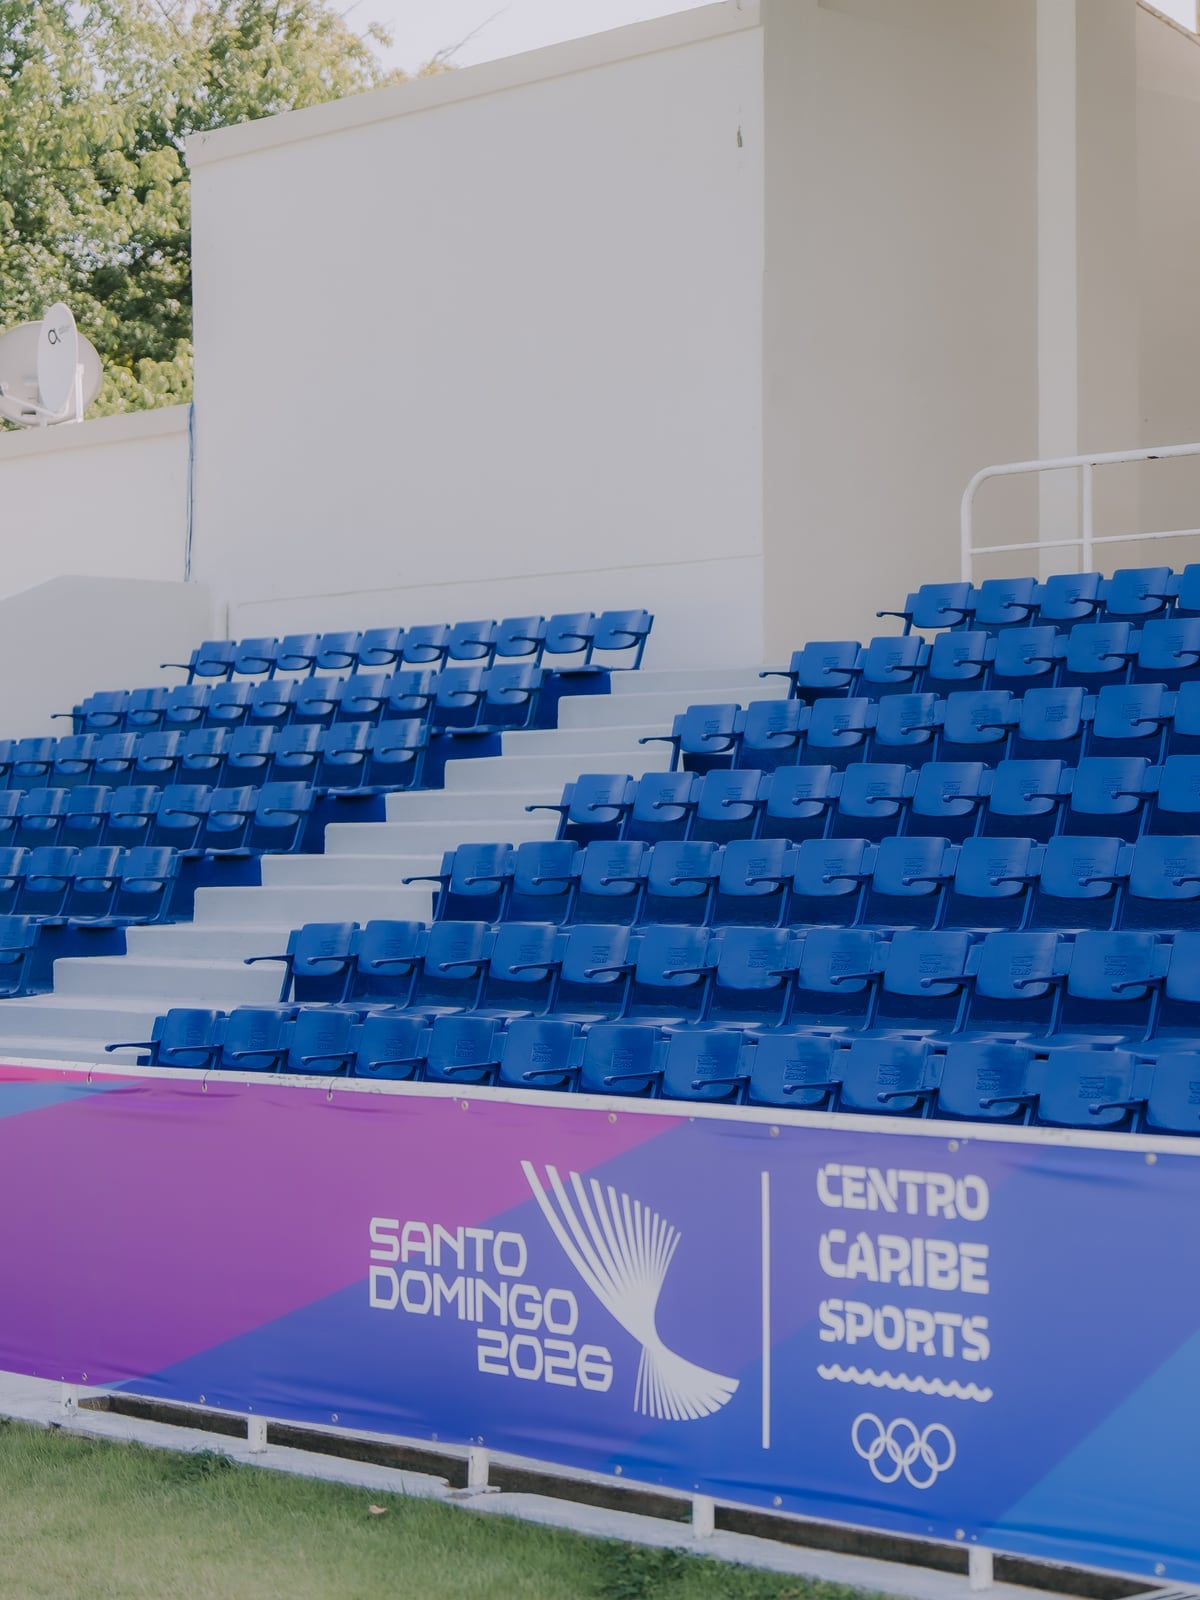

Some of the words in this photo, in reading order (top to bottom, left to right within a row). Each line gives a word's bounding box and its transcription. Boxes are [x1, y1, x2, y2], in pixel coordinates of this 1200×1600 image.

[815, 1162, 991, 1222] CENTRO
[368, 1216, 529, 1278] SANTO
[816, 1227, 991, 1295] CARIBE
[368, 1264, 580, 1337] DOMINGO
[818, 1297, 991, 1363] SPORTS
[476, 1327, 614, 1393] 2026
